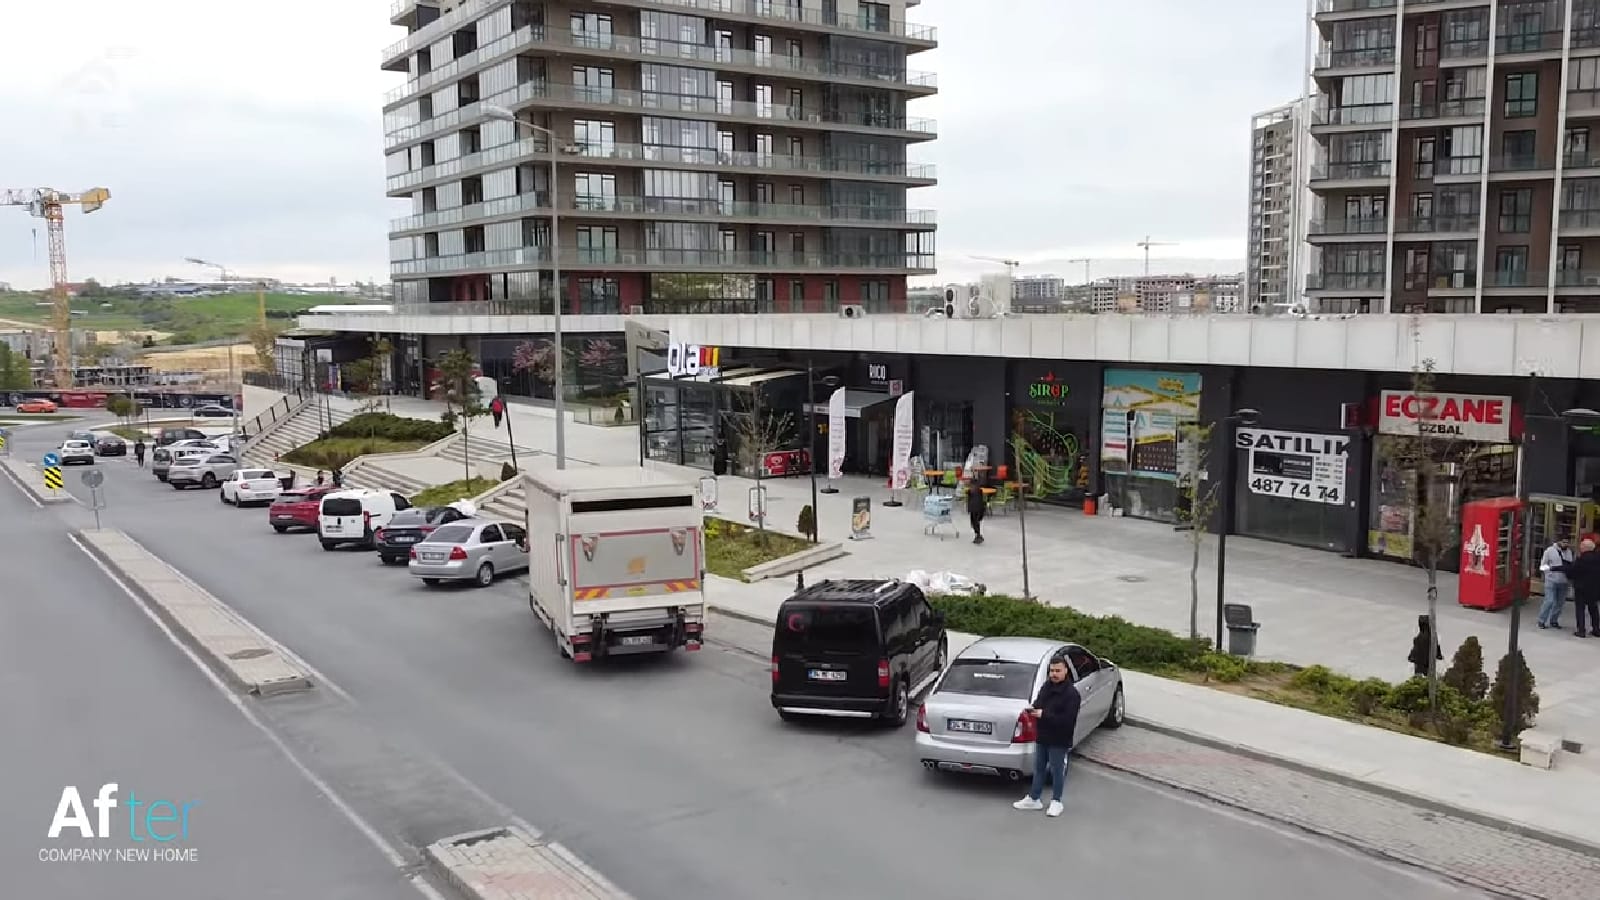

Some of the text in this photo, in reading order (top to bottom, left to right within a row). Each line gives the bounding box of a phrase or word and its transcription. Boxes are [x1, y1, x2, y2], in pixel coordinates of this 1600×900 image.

[1386, 394, 1503, 425] ECZANE
[1237, 433, 1350, 455] SATILIK
[1251, 478, 1339, 502] 487 74 74
